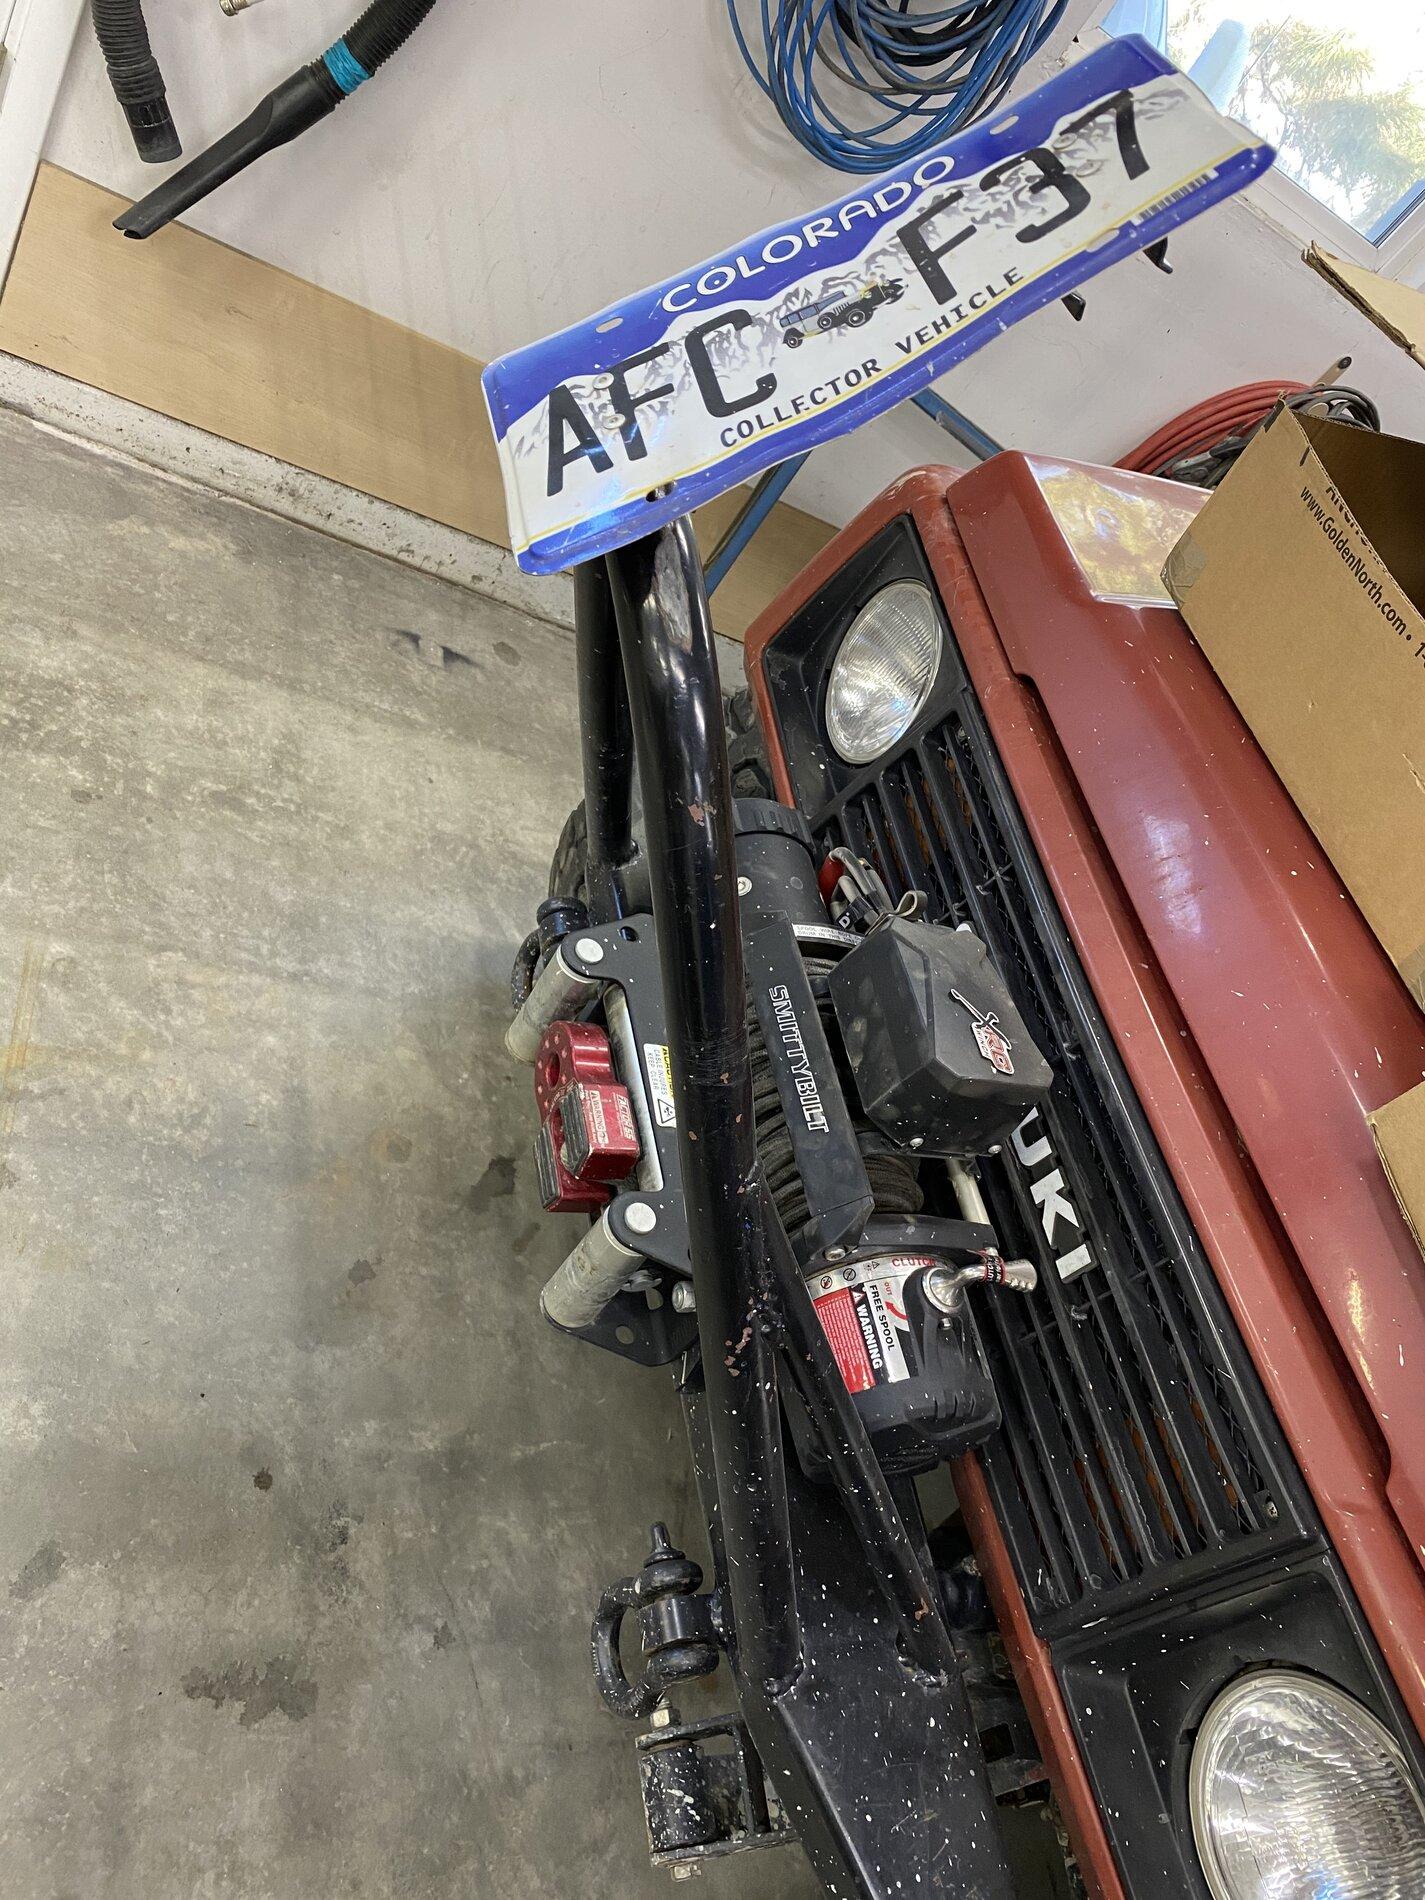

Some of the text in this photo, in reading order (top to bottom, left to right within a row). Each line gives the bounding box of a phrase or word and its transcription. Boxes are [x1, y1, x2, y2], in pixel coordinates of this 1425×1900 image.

[547, 88, 1150, 497] AFC F37
[661, 155, 955, 313] COLORADO
[720, 267, 1024, 448] COLLECTOR VEHICLE
[1300, 486, 1407, 636] www.GoldenNorth.com
[768, 984, 830, 1133] SMITTYBILT
[1011, 1106, 1092, 1280] UKI
[856, 1304, 883, 1370] WARNING
[869, 1284, 895, 1352] FREE SPOOL
[884, 1281, 893, 1296] OUT
